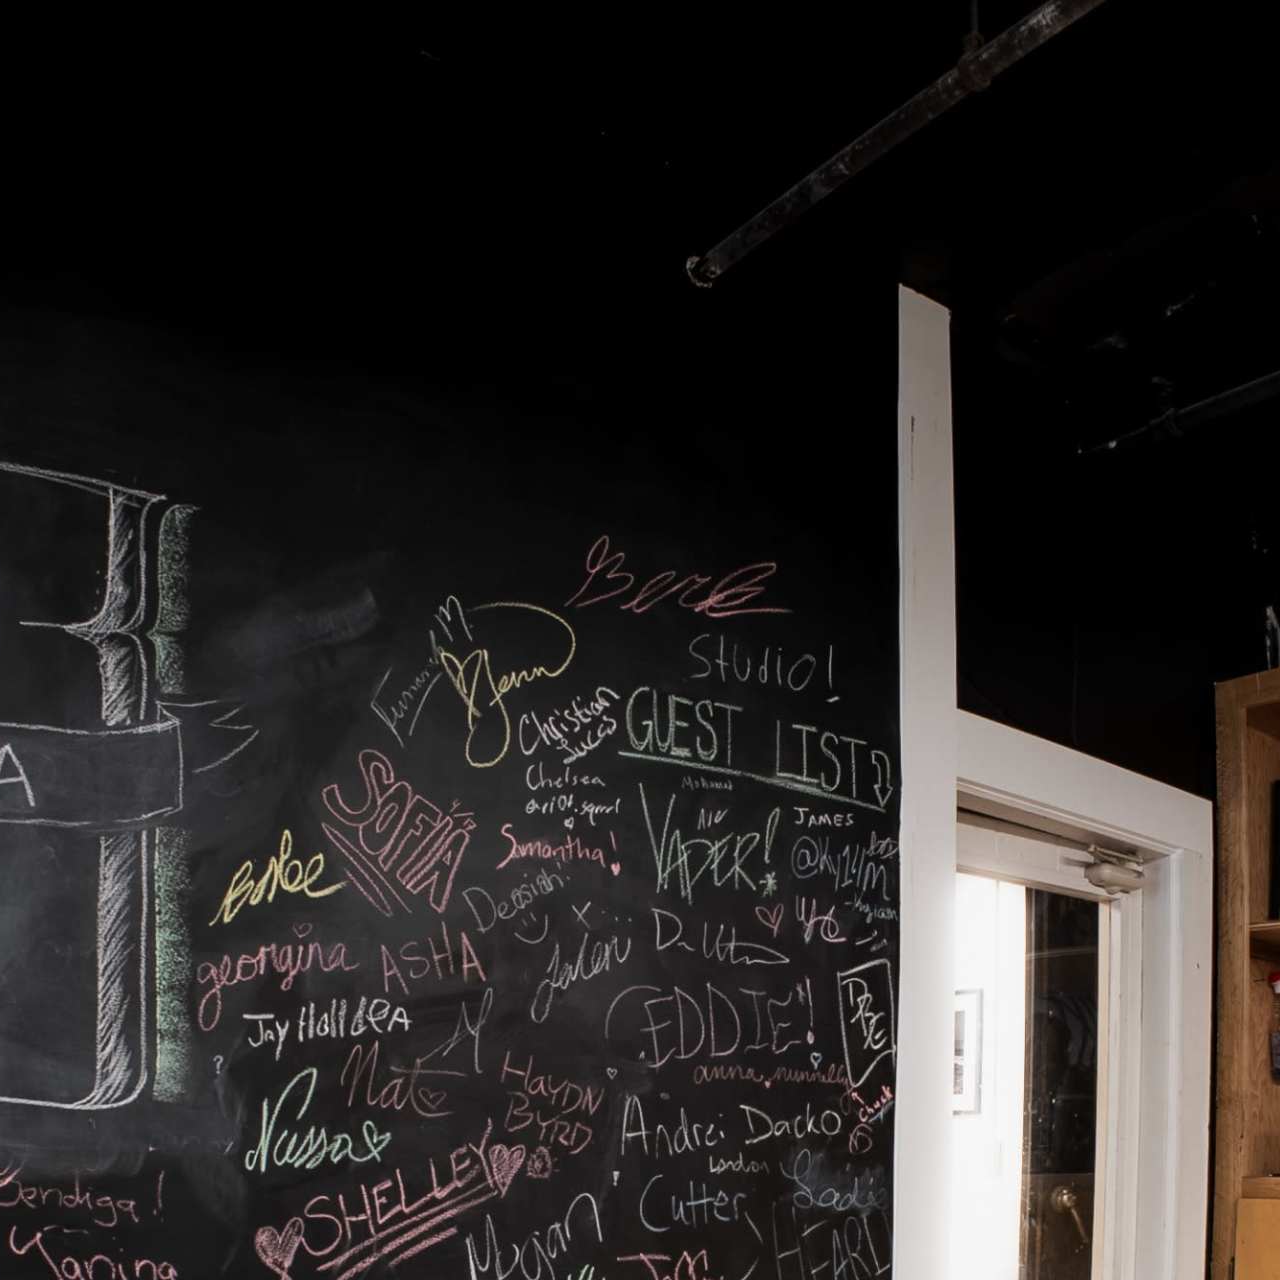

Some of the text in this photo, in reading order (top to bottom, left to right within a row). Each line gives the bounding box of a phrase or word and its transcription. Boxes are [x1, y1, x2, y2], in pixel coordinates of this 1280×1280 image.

[518, 686, 620, 756] Christian
[625, 686, 868, 800] GUEST LIST
[525, 763, 606, 791] Chelsea
[792, 807, 855, 828] JAMES
[380, 921, 487, 995] ASHA
[302, 1117, 495, 1256] SHELLEY
[639, 1174, 745, 1232] Cutter
